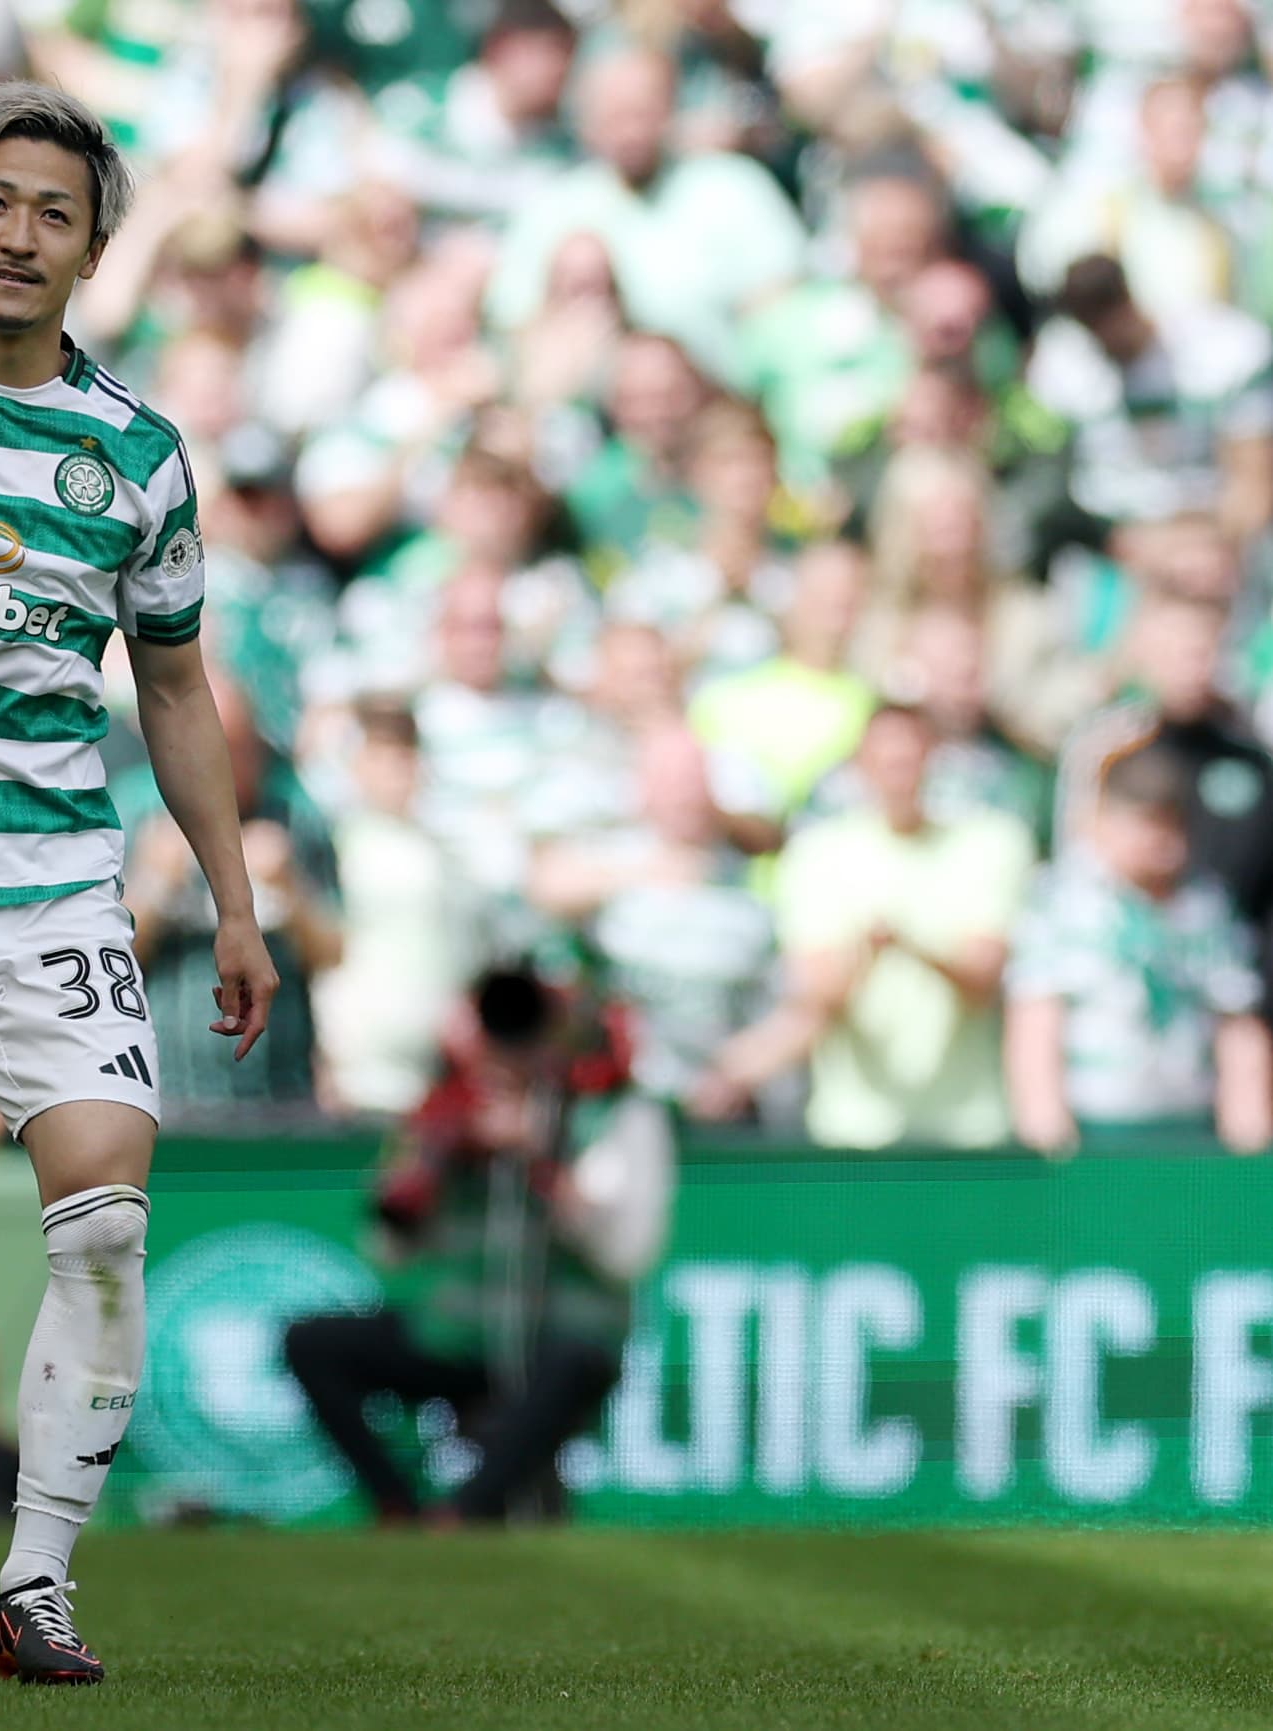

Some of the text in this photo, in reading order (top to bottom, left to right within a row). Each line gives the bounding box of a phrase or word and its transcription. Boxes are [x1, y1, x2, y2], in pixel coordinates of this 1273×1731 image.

[40, 946, 146, 1021] 38
[417, 1259, 925, 1498] LTIC
[954, 1264, 1157, 1503] FC
